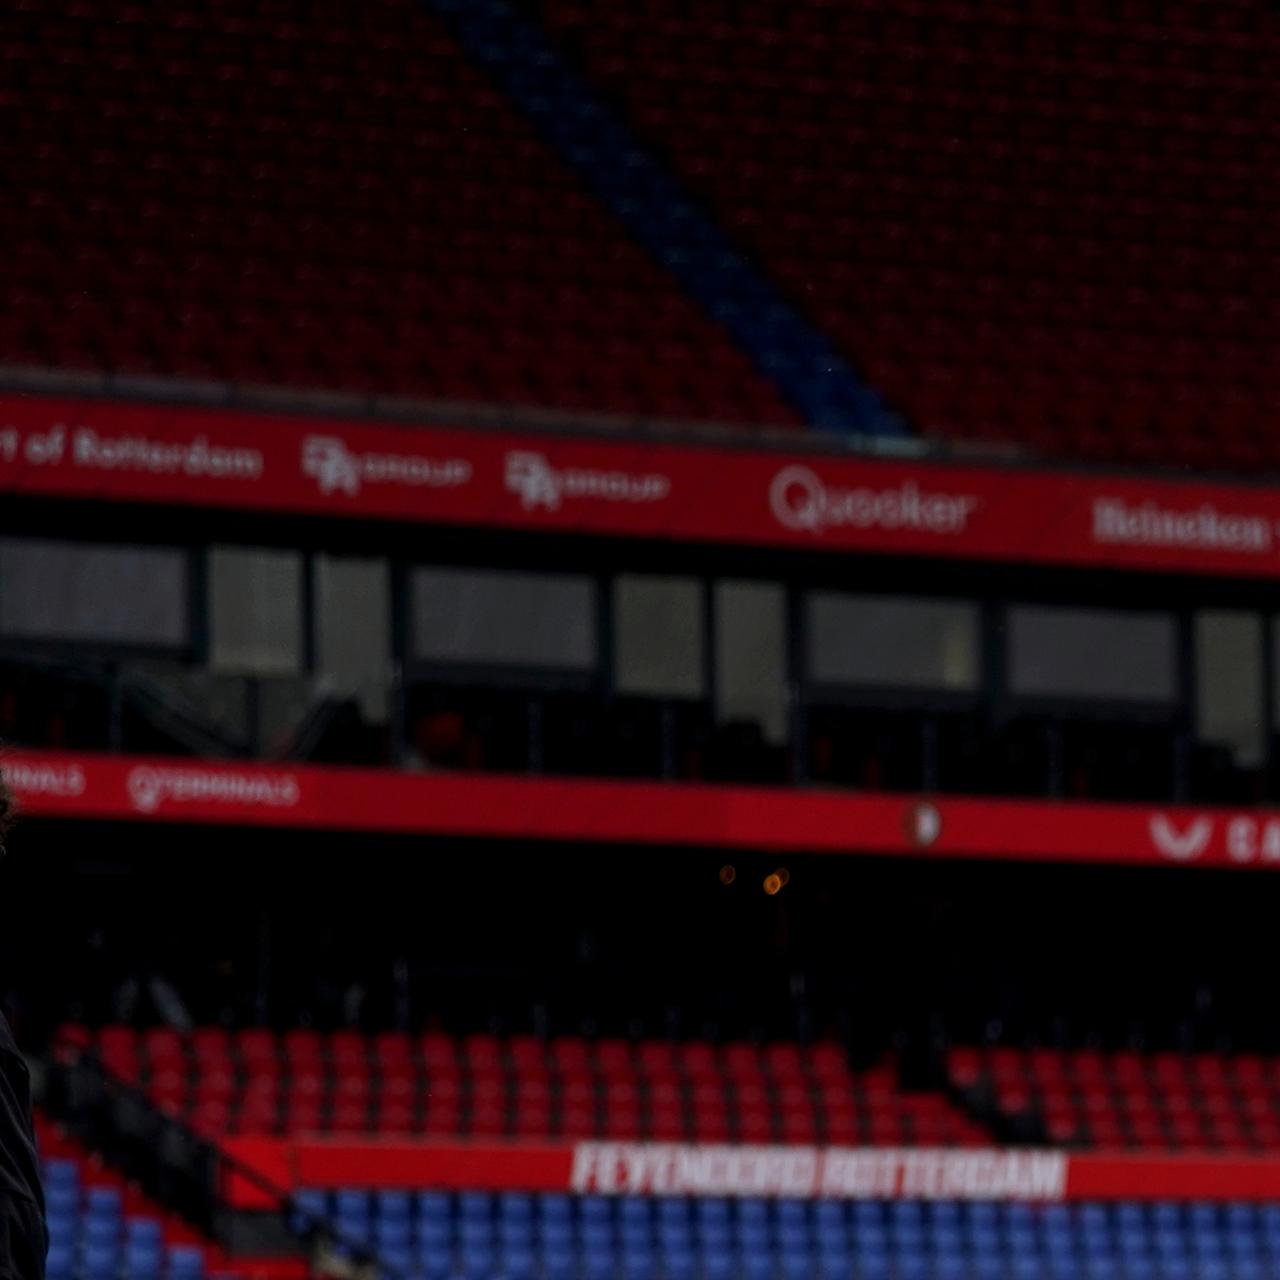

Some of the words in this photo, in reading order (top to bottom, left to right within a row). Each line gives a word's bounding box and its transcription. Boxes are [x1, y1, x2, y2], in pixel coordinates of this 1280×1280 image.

[24, 423, 66, 465] of
[72, 426, 265, 480] Rotterdam
[570, 1142, 818, 1195] FEYENOORD
